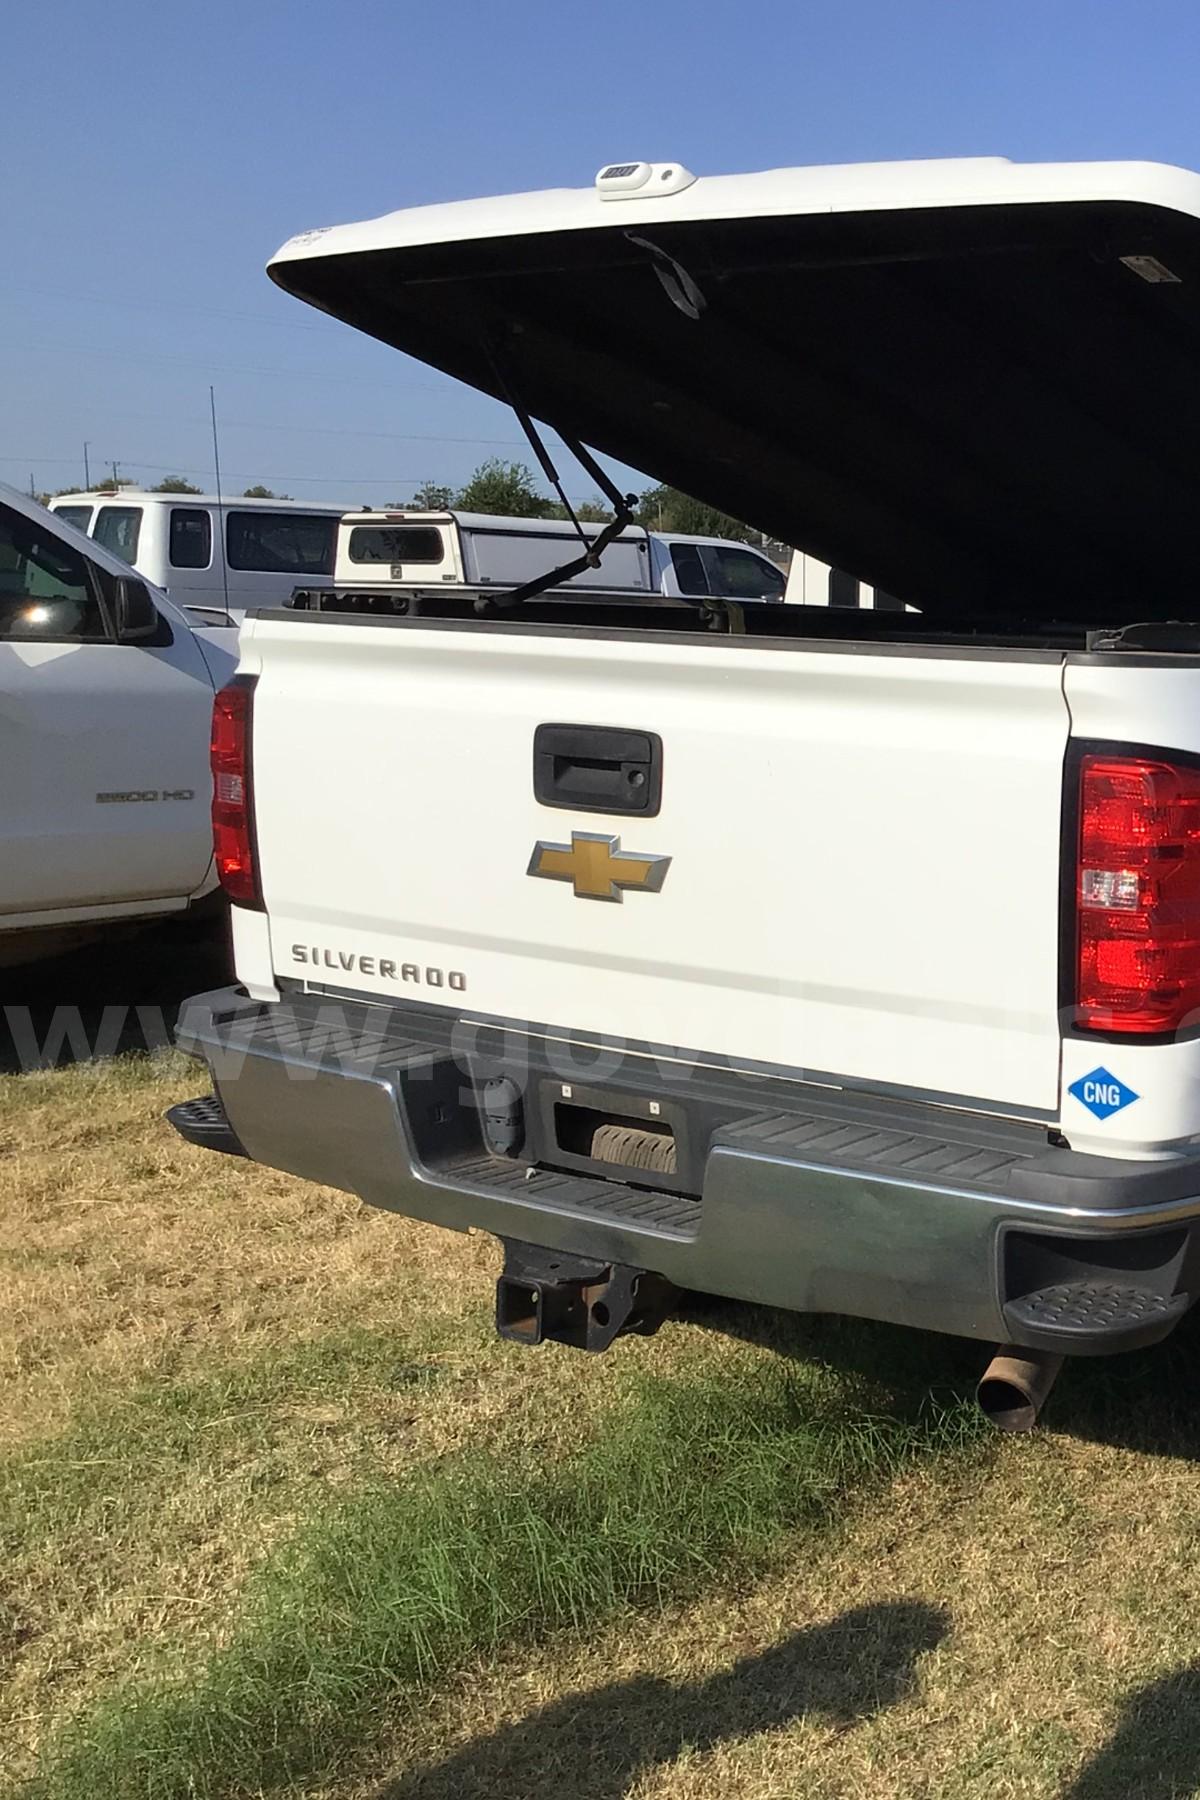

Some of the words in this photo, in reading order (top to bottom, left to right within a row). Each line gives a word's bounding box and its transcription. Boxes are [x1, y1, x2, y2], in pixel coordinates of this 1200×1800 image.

[162, 789, 195, 801] HD
[291, 944, 468, 992] SILVERADO
[1083, 1081, 1121, 1107] CNG
